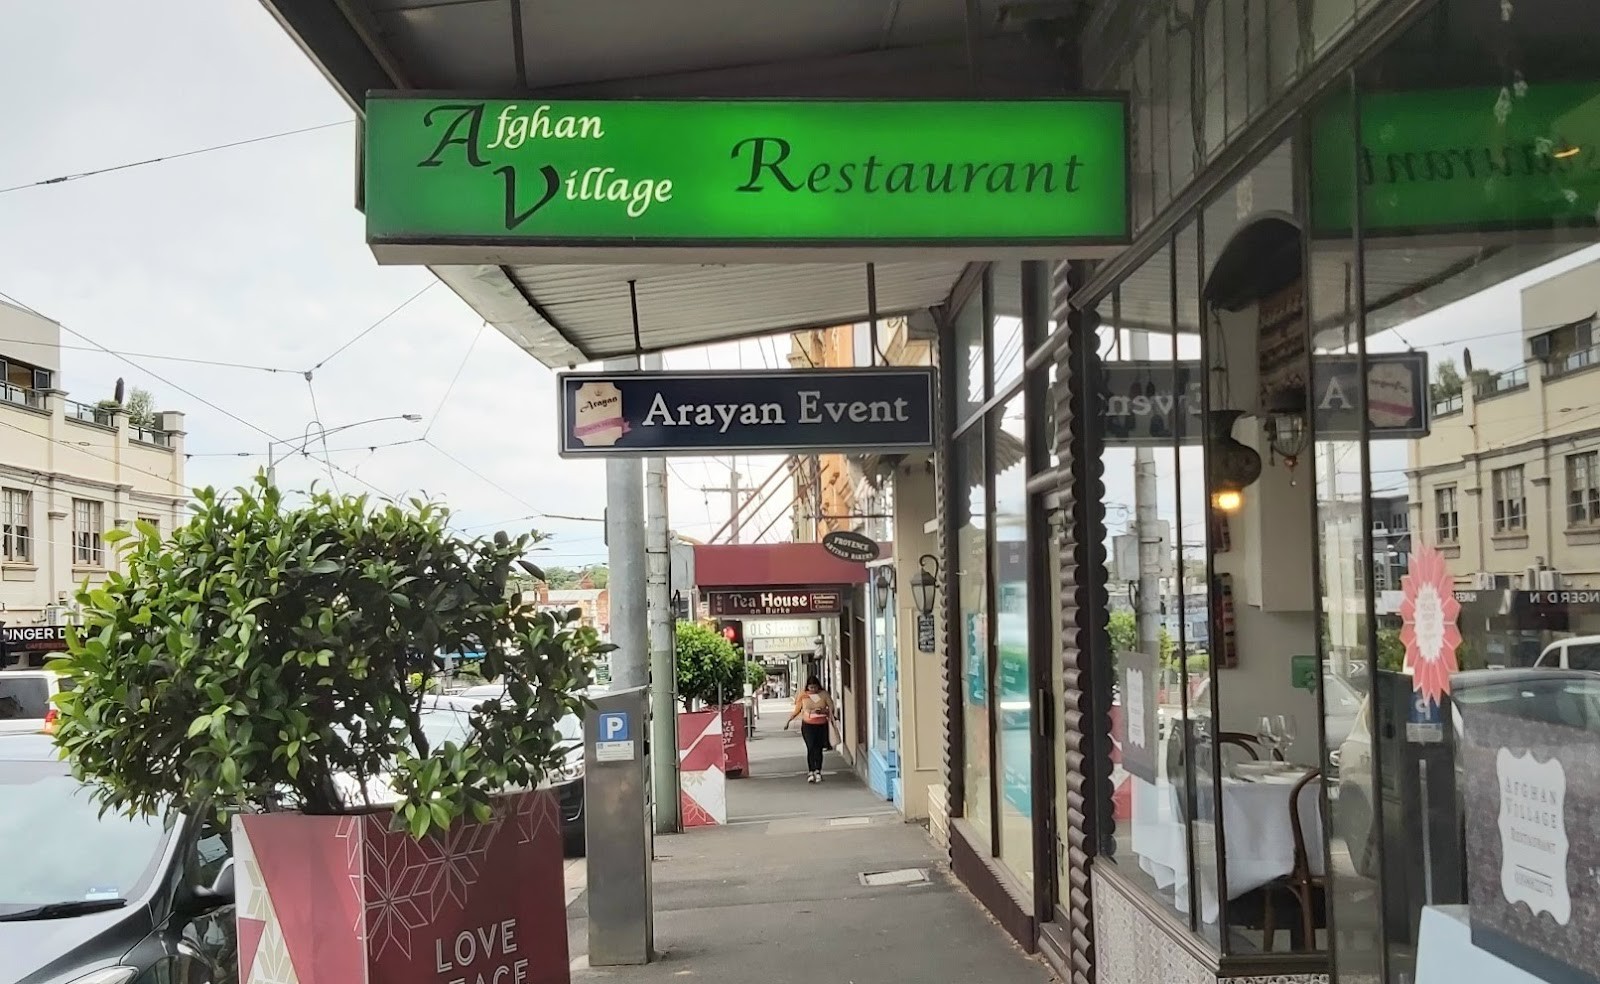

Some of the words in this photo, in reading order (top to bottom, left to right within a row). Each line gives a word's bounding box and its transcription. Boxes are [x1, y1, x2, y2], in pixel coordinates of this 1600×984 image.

[417, 103, 604, 168] Afghan
[731, 137, 1085, 194] Restaurant
[493, 164, 673, 230] Village
[642, 392, 786, 433] Arayan
[797, 390, 909, 424] Event
[833, 536, 870, 551] PROVENCE
[729, 593, 756, 608] Tea
[760, 592, 808, 607] House
[765, 606, 791, 614] Burke
[606, 717, 624, 739] P
[1505, 776, 1556, 805] AFGHAN
[1505, 797, 1556, 829] VILLAGE
[435, 918, 518, 974] LOVE
